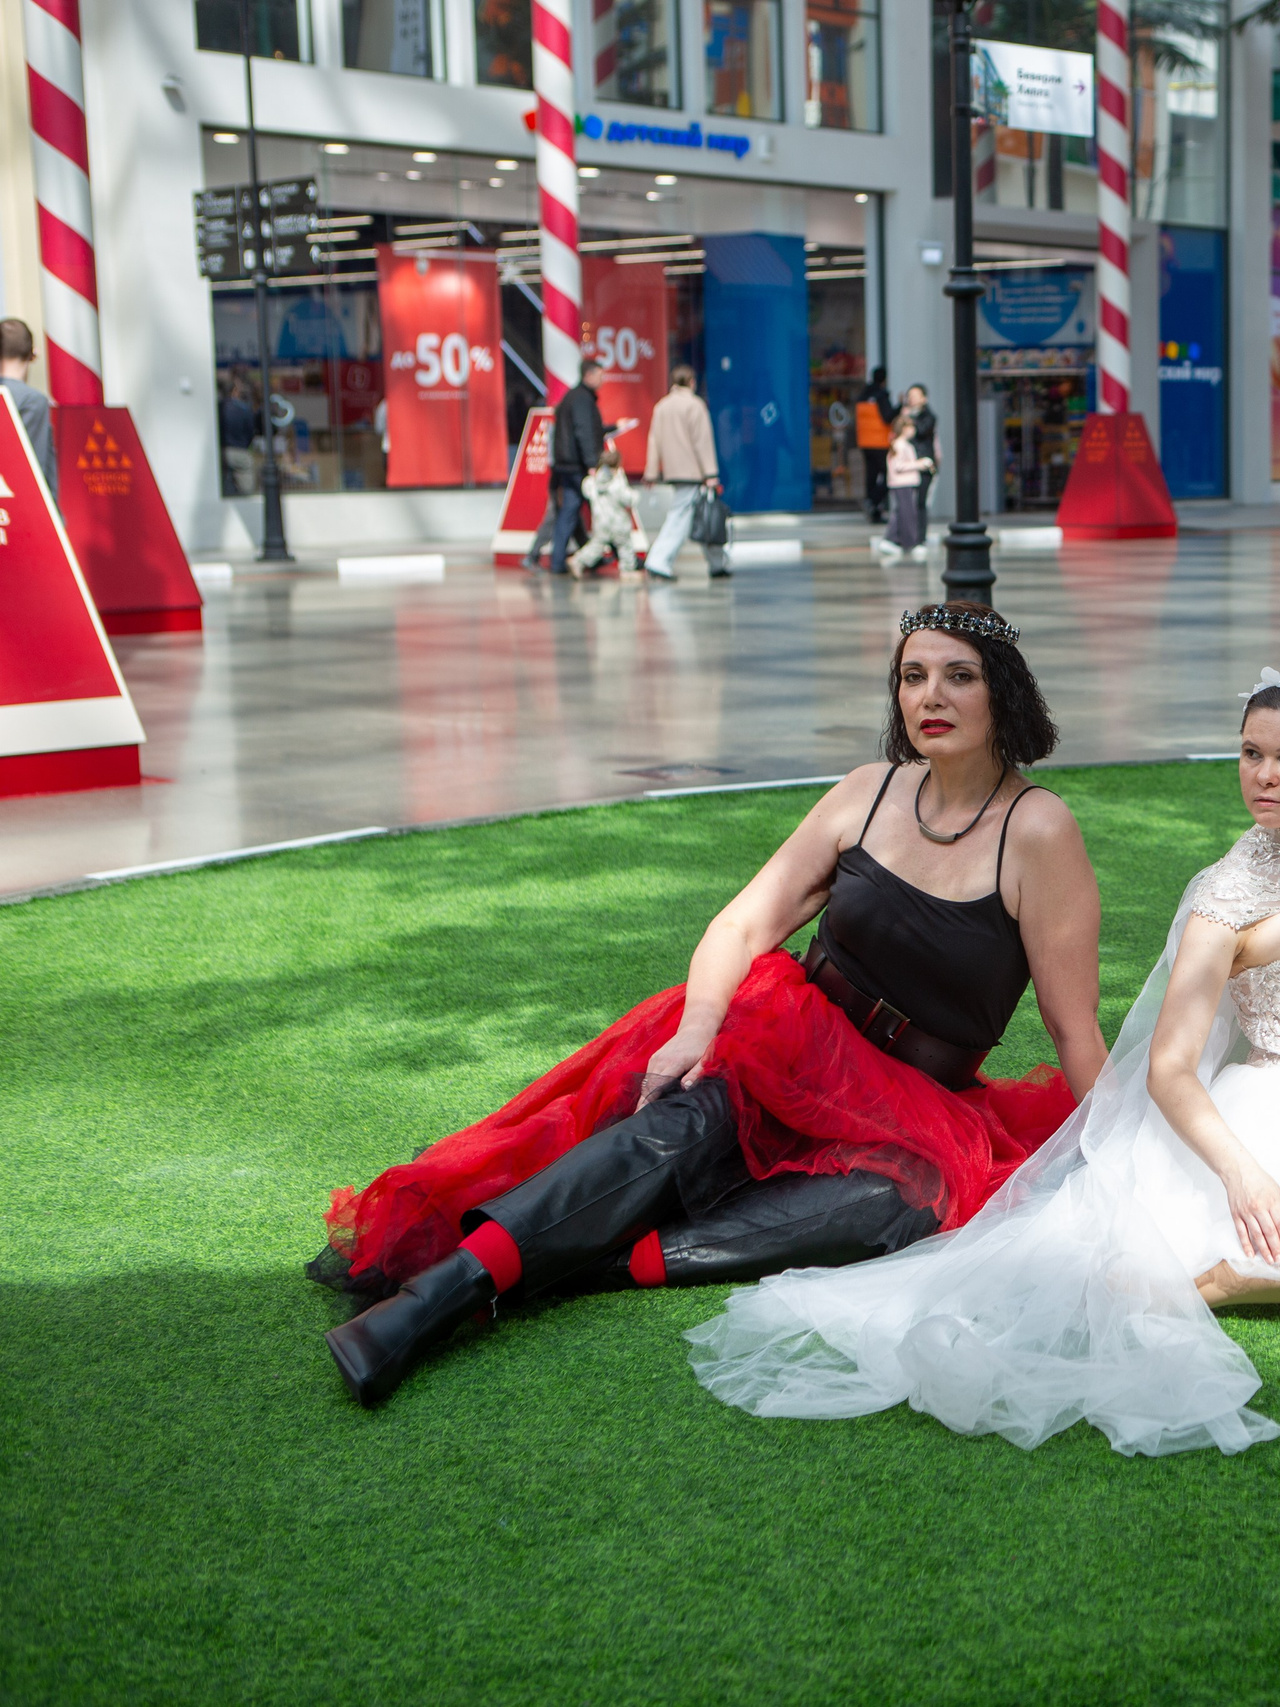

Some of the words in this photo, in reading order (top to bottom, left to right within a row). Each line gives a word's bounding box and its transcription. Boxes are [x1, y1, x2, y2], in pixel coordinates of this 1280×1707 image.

[606, 121, 703, 148] детский
[707, 133, 750, 159] мир
[414, 331, 495, 388] 50%
[596, 326, 655, 371] 50%
